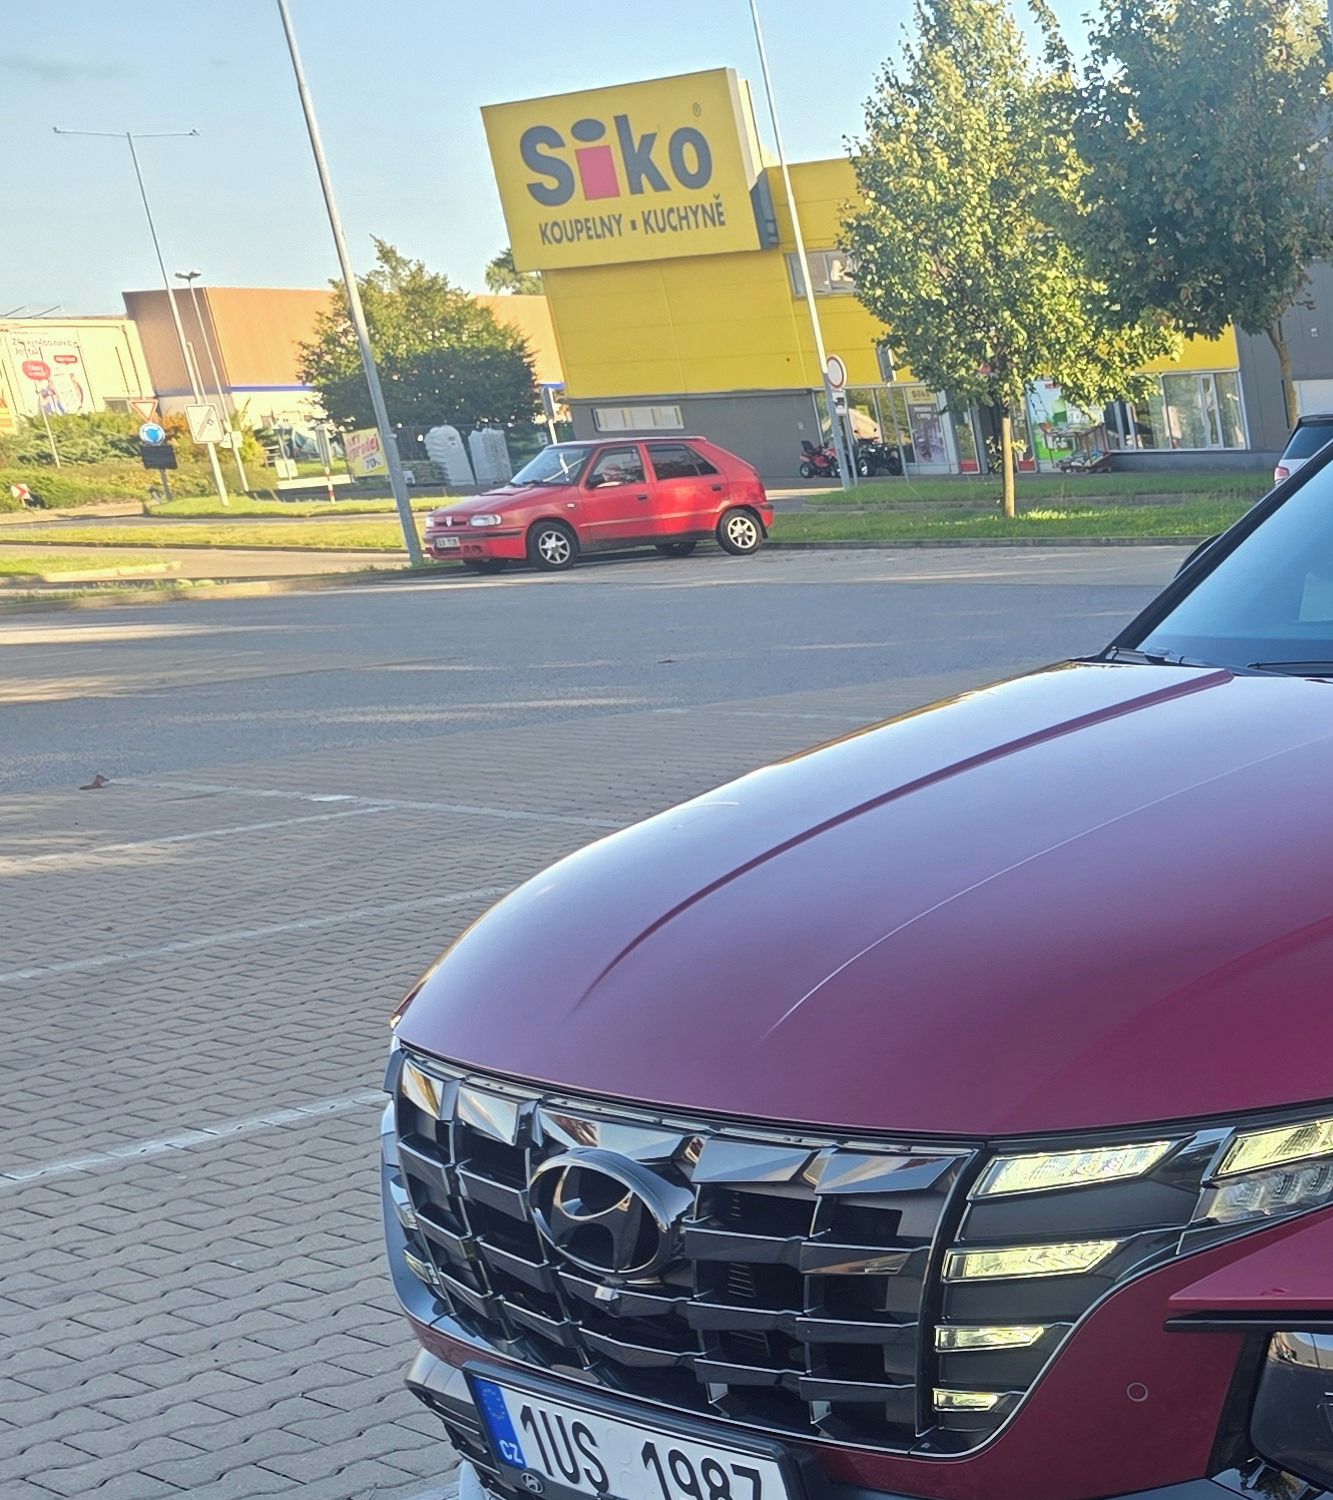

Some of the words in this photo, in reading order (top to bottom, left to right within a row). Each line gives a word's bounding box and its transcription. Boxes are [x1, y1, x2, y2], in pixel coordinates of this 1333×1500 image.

[519, 114, 713, 207] Siko
[539, 213, 623, 246] KOUPELNY
[641, 193, 726, 236] KUCHYNĚ
[498, 1438, 525, 1465] CZ
[519, 1403, 610, 1495] 1US
